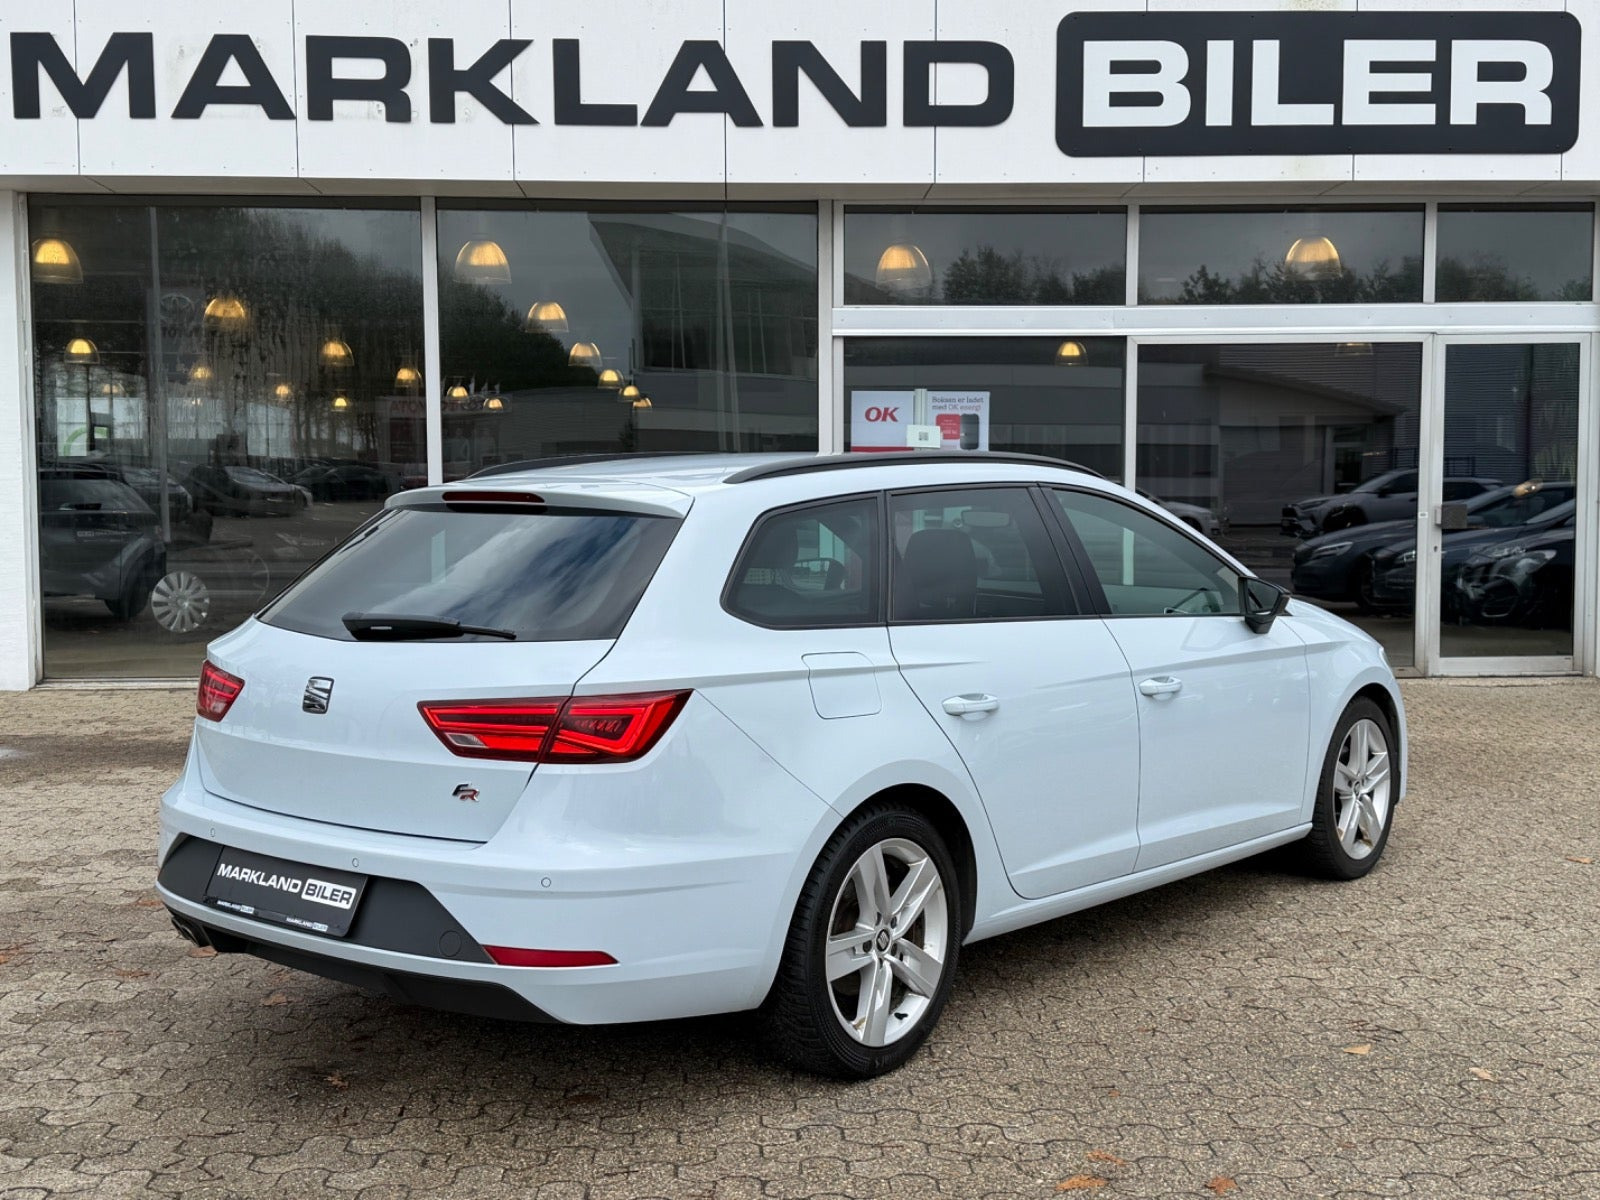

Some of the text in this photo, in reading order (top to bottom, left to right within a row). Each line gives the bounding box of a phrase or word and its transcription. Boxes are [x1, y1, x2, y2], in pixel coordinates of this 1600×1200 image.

[10, 32, 1554, 128] MARKLAND BILER
[864, 406, 899, 422] OK
[217, 863, 353, 905] MARKLAND BILER
